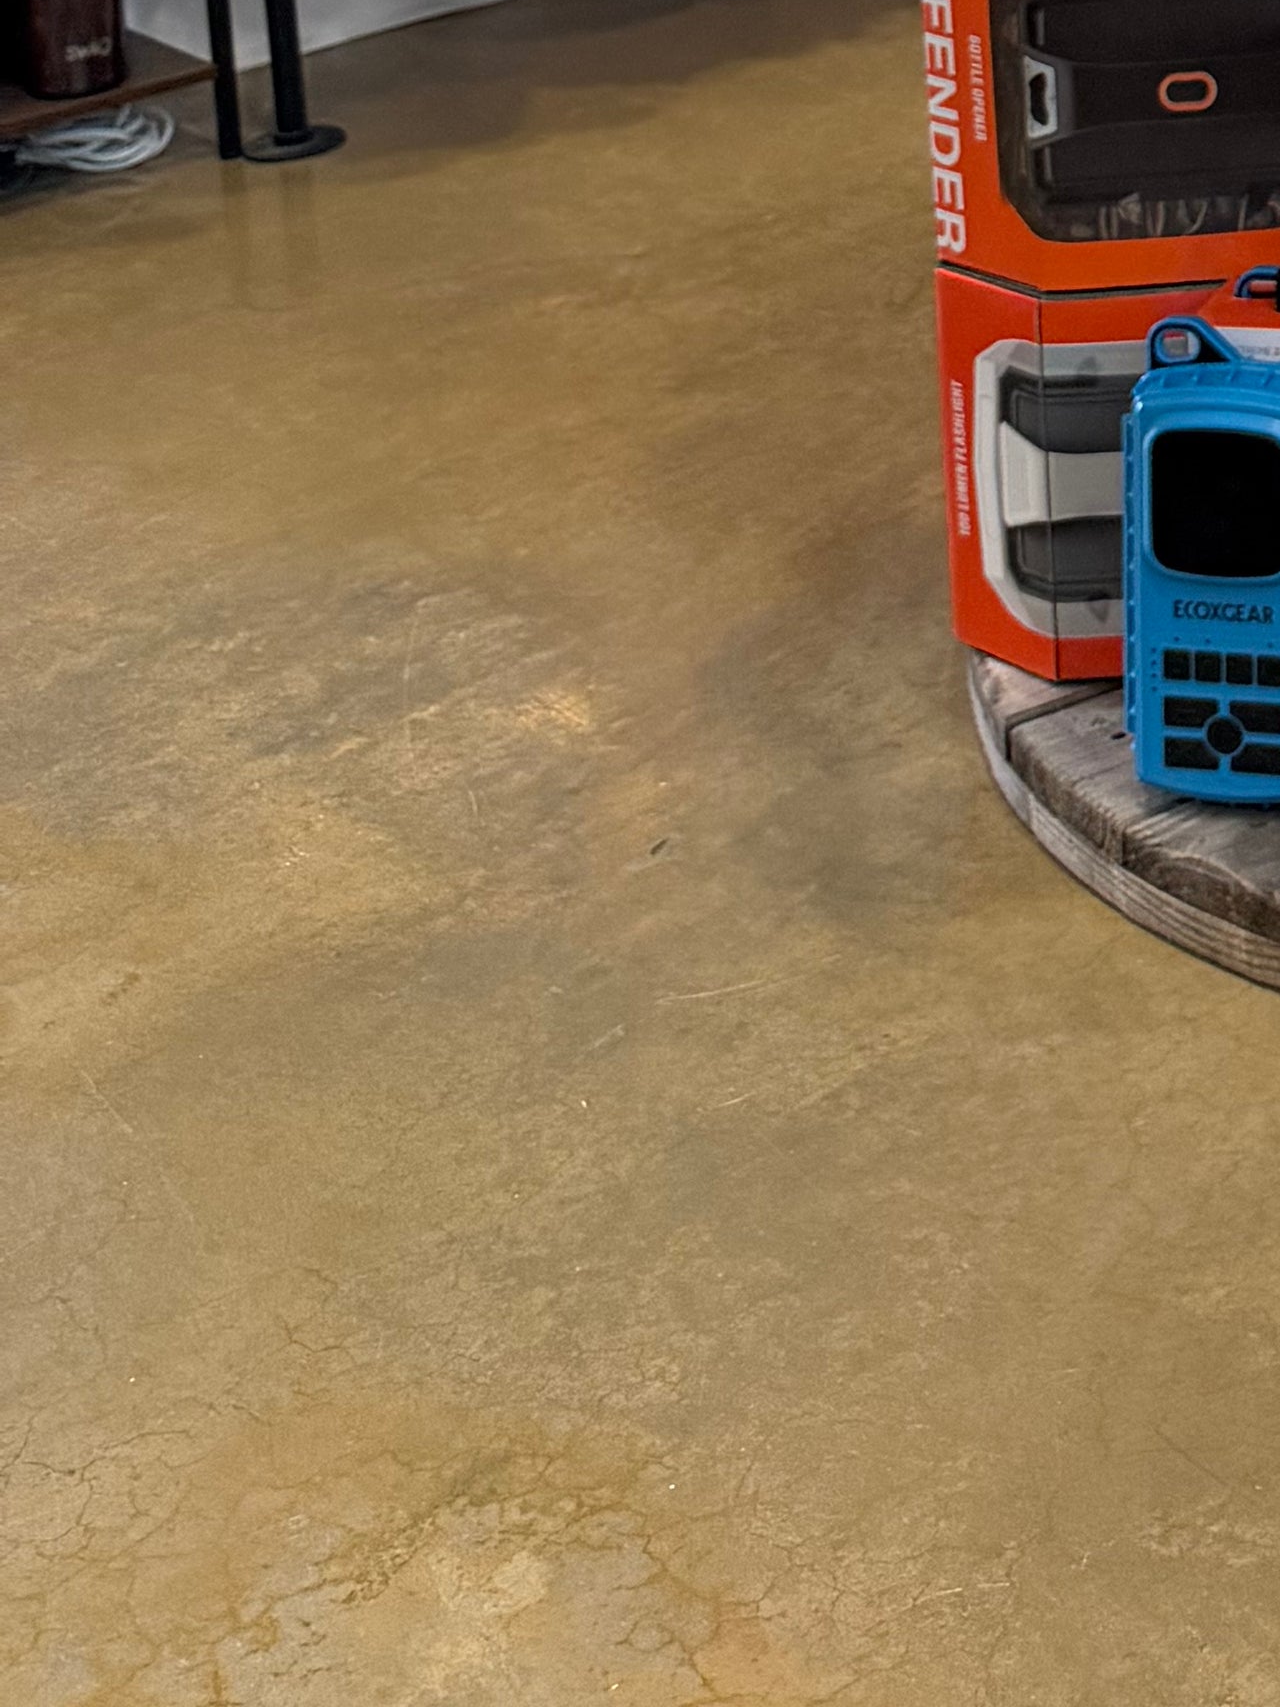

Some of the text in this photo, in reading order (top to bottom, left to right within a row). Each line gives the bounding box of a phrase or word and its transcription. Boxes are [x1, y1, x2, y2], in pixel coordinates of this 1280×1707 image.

[968, 34, 989, 143] BOTTLE OPENER
[950, 378, 968, 462] FLASHLIGHT
[954, 462, 970, 511] LUMEN
[1172, 598, 1275, 625] ECOXGEAR
